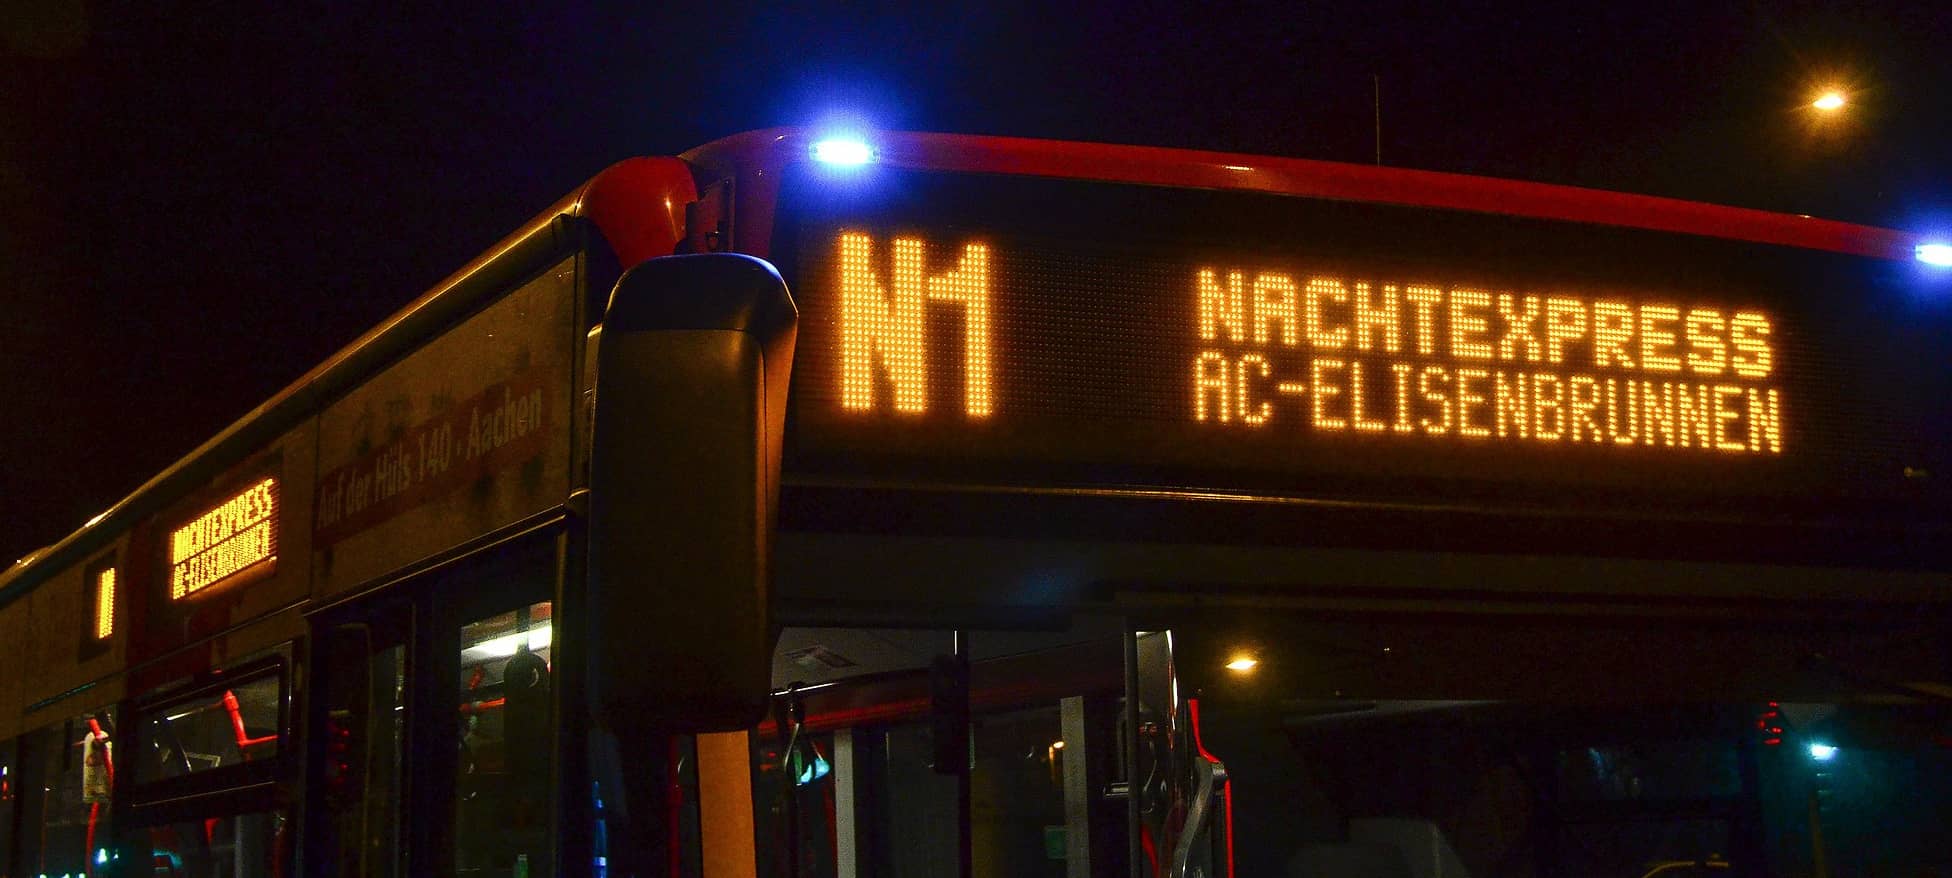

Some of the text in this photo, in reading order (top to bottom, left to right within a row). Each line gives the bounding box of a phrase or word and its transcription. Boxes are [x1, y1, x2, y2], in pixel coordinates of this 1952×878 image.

[842, 234, 989, 416] N1
[1199, 269, 1773, 378] NACHTEXPRESS
[317, 471, 345, 529] Auf
[345, 467, 371, 516] der
[416, 420, 453, 484] 140
[465, 385, 545, 461] Aachen
[1196, 350, 1782, 454] AC-ELISENBRUNNEN
